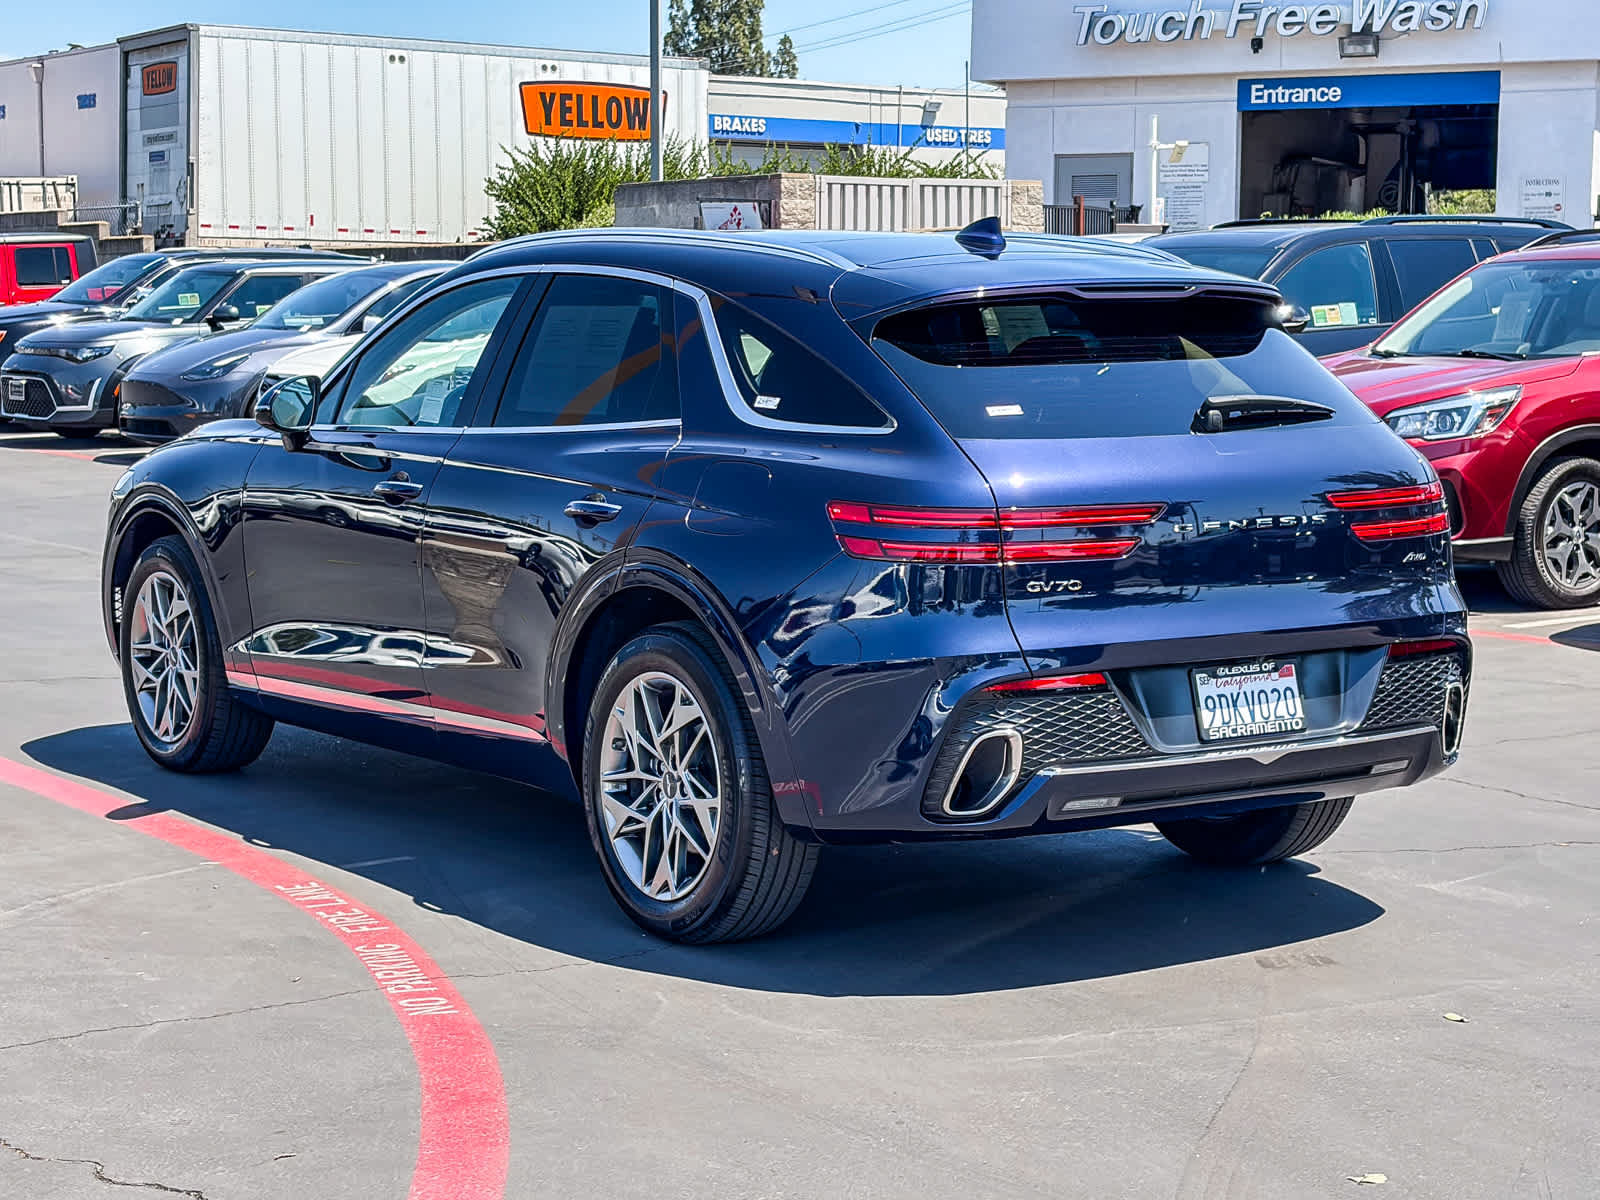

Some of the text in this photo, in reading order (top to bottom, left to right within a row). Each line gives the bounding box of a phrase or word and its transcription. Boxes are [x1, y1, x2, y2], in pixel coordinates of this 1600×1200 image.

[1073, 0, 1489, 46] Touch Free Wash
[145, 67, 174, 90] YELLOW
[1250, 84, 1342, 105] Entrance
[539, 92, 650, 131] YELLOW
[713, 116, 767, 134] BRAKES
[926, 128, 992, 145] USED TRES
[1525, 178, 1560, 186] INSTRUCTIONS
[1173, 514, 1328, 533] GENESIS
[1026, 579, 1083, 593] GV70
[1225, 664, 1260, 675] LEXUS
[1262, 662, 1276, 671] OF
[1215, 673, 1273, 691] California
[1204, 686, 1298, 727] 9DKV020
[1208, 718, 1303, 740] SACRAMENTO
[274, 881, 460, 1016] NO PARKING FIRE LANE
